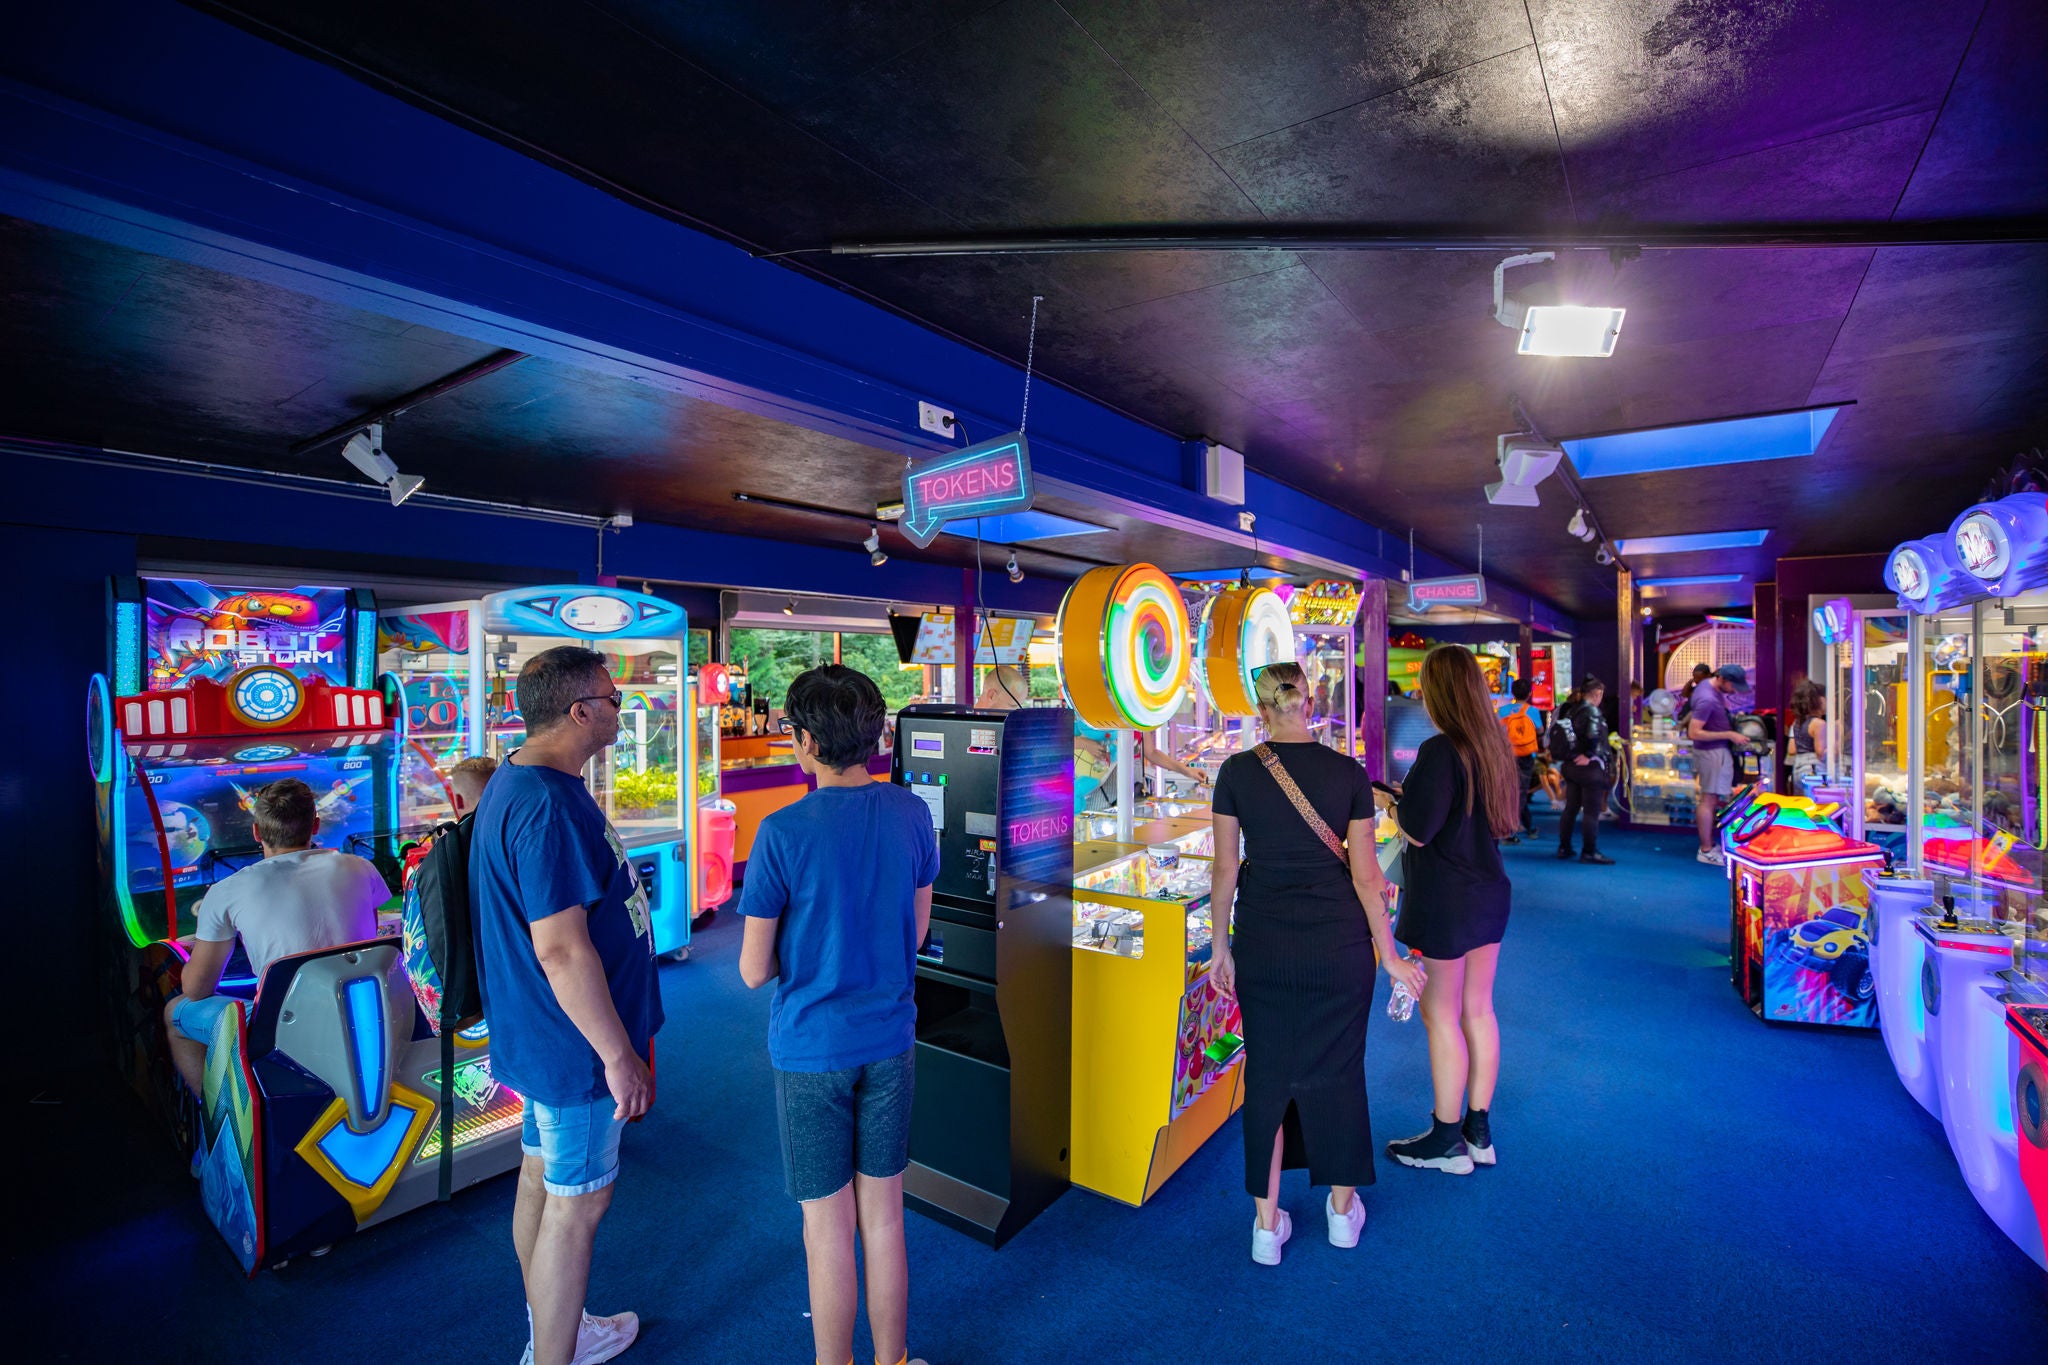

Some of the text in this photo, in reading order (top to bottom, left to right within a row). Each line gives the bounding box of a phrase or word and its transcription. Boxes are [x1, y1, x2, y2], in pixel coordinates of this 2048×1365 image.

[919, 462, 1014, 503] TOKENS
[1415, 583, 1476, 598] CHANGE
[170, 629, 327, 650] ROBOT
[239, 651, 333, 663] STORM
[1393, 749, 1418, 760] CHA
[343, 761, 363, 770] 800
[1010, 815, 1068, 844] TOKENS
